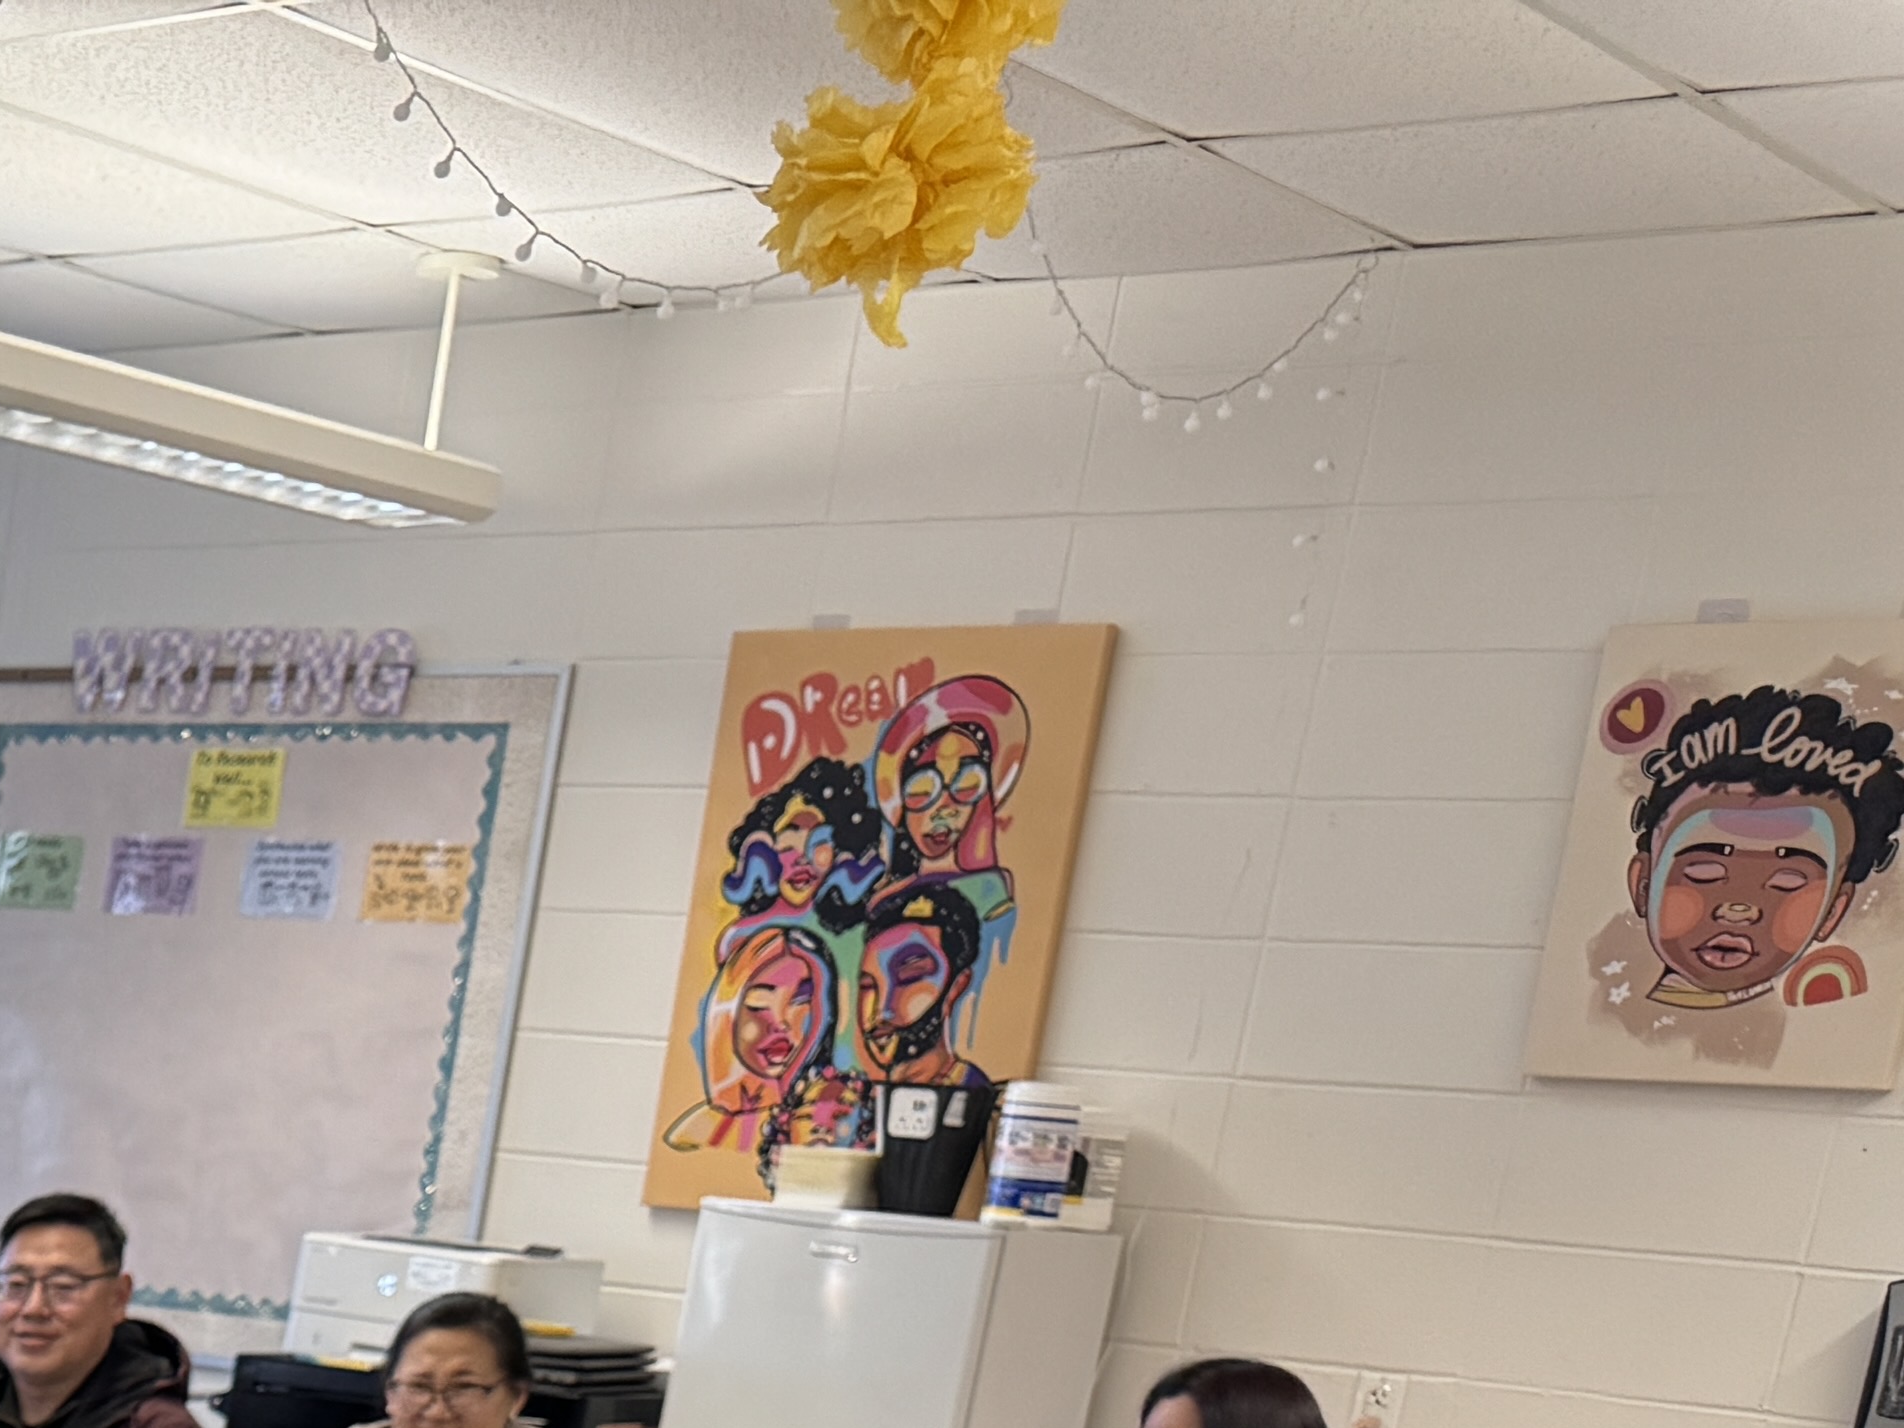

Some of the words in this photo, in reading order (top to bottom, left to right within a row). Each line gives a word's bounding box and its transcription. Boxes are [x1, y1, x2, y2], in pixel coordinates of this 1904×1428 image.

[73, 627, 416, 716] WRITING
[1650, 752, 1684, 787] I
[1680, 716, 1737, 770] am
[1741, 707, 1881, 796] loved
